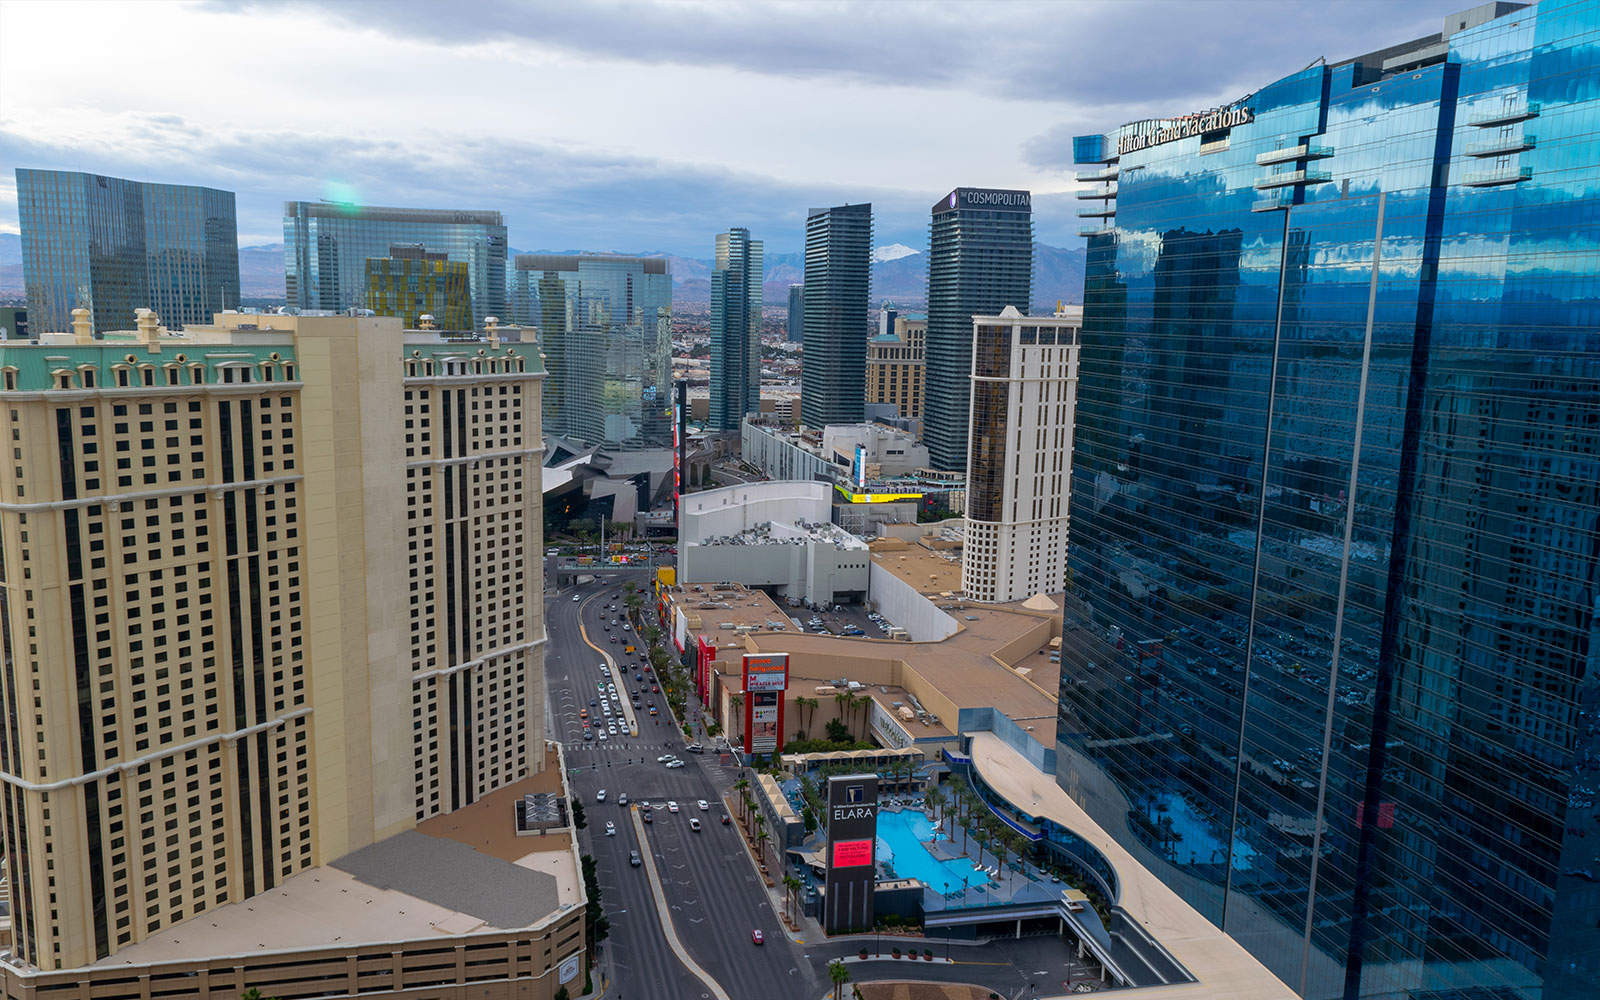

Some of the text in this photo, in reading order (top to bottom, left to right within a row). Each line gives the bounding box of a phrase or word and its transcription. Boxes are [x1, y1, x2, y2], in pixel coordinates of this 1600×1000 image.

[1117, 106, 1249, 155] Hilton Grand Vacations
[967, 191, 1031, 206] COSMOPOLITAN
[834, 808, 873, 820] ELARA
